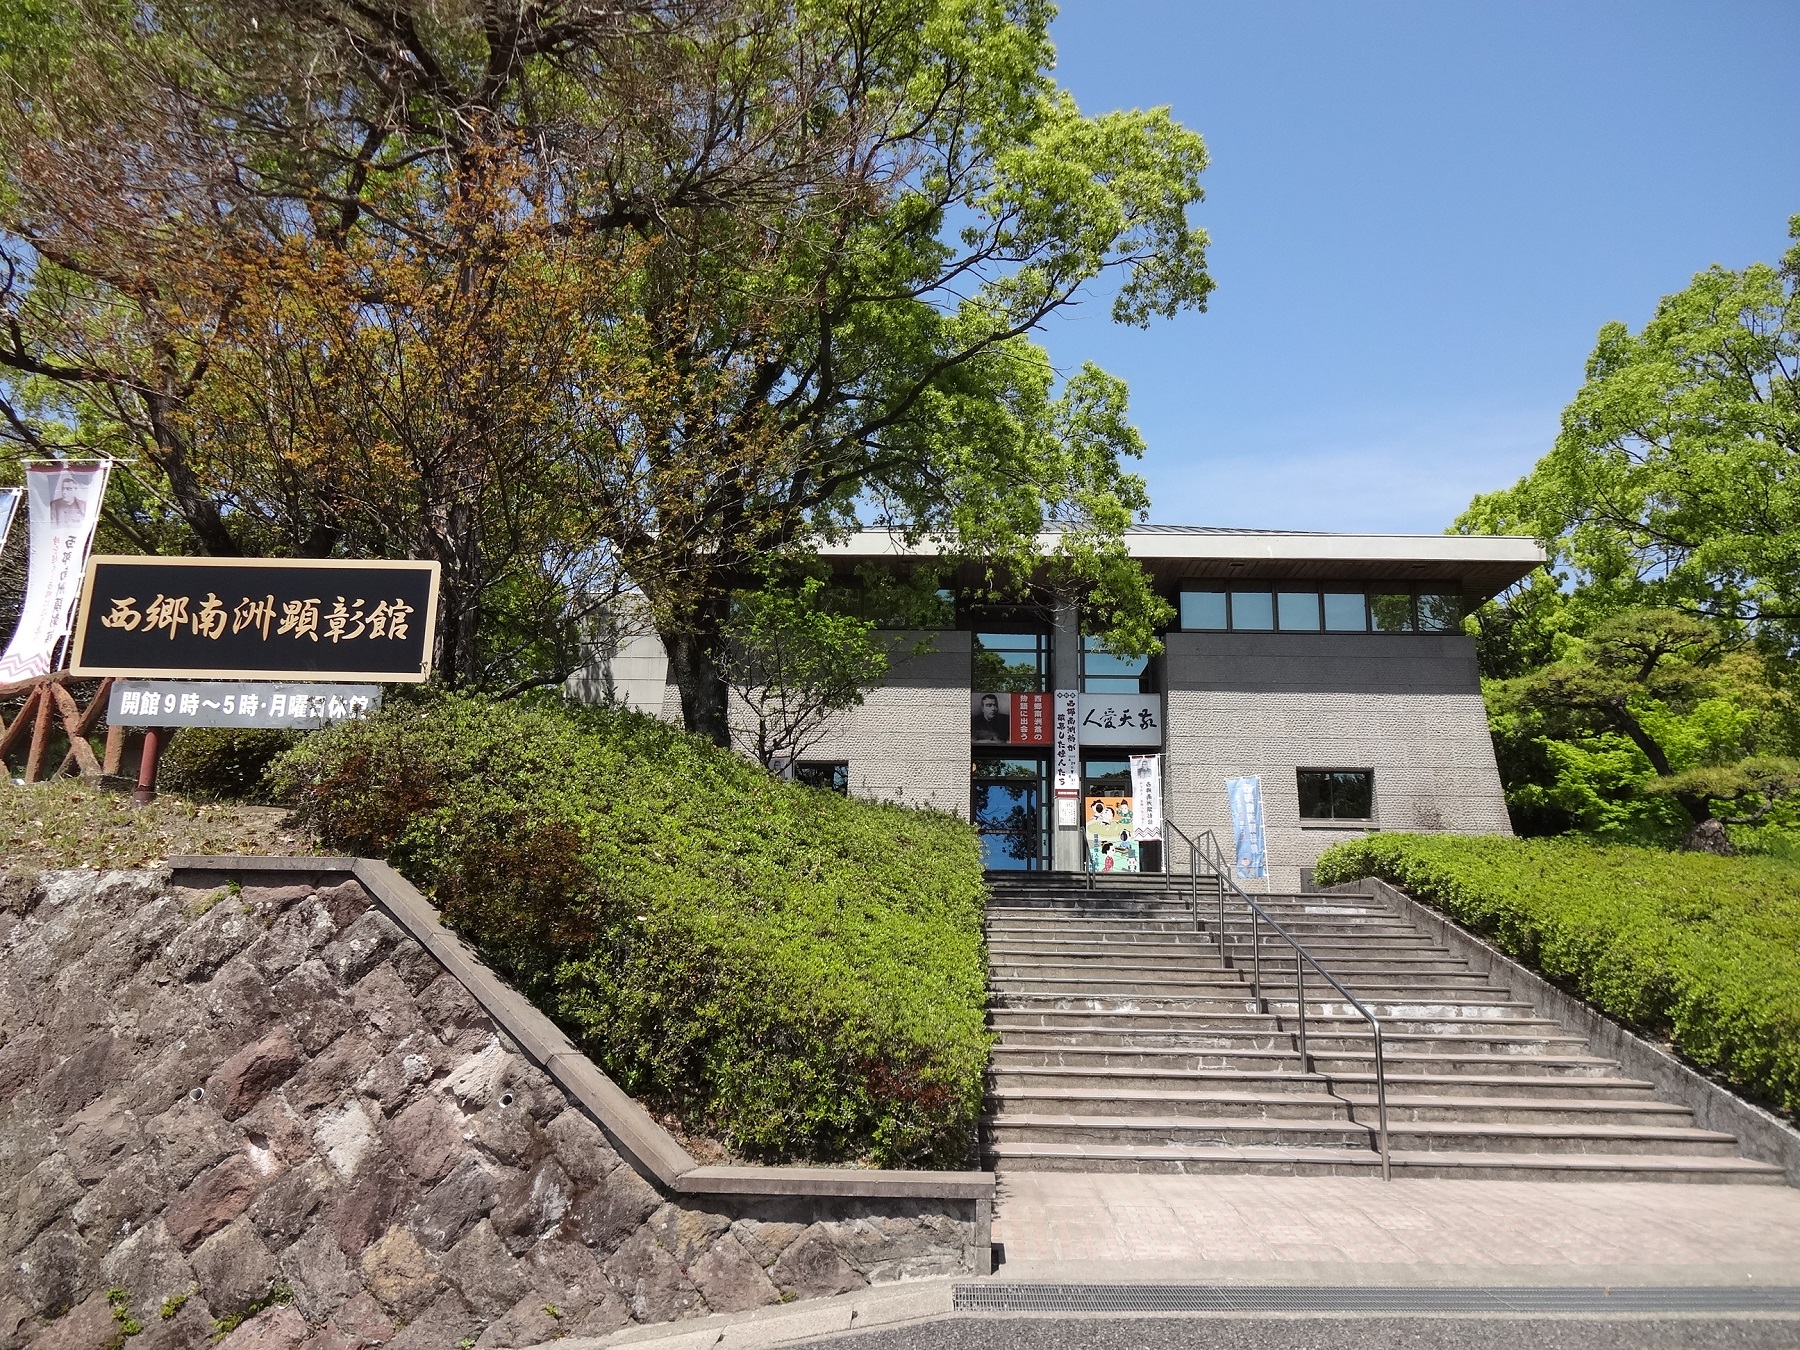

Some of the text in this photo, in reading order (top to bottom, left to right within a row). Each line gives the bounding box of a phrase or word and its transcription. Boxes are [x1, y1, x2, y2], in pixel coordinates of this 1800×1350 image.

[100, 592, 415, 643] 西郷南洲顕彰館
